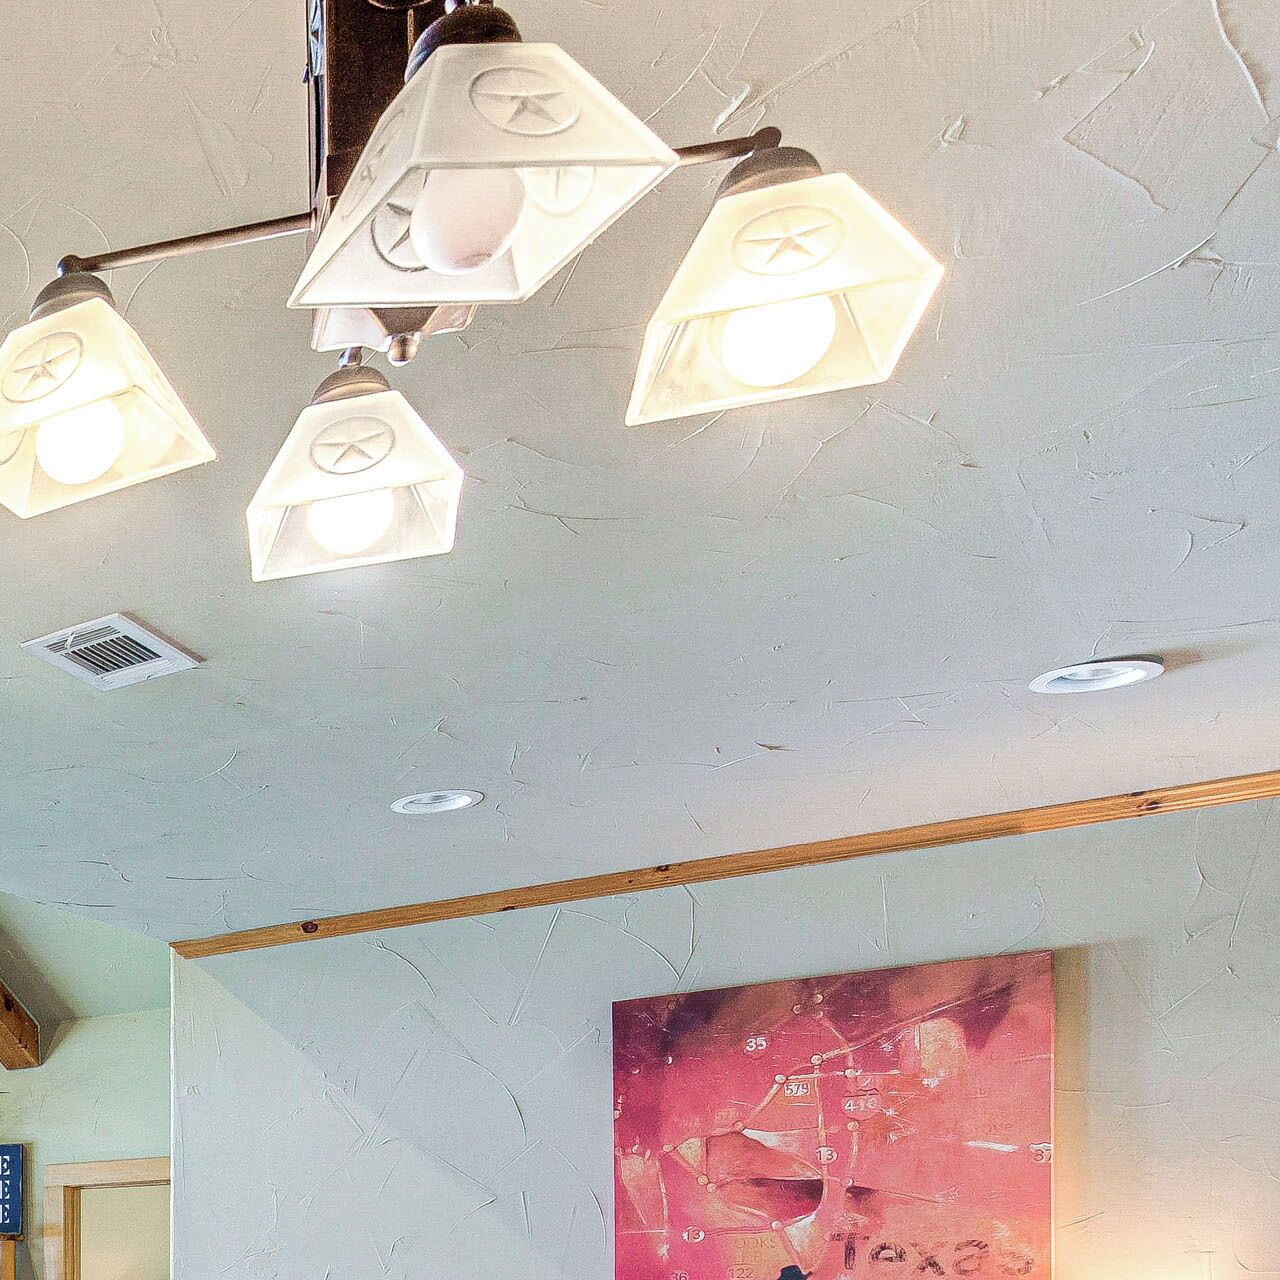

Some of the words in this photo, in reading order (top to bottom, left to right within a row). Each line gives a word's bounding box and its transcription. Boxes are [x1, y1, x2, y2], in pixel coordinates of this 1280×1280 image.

[745, 1037, 767, 1052] 35
[817, 1149, 835, 1161] 13
[685, 1229, 701, 1240] 13
[728, 1267, 754, 1280] 122
